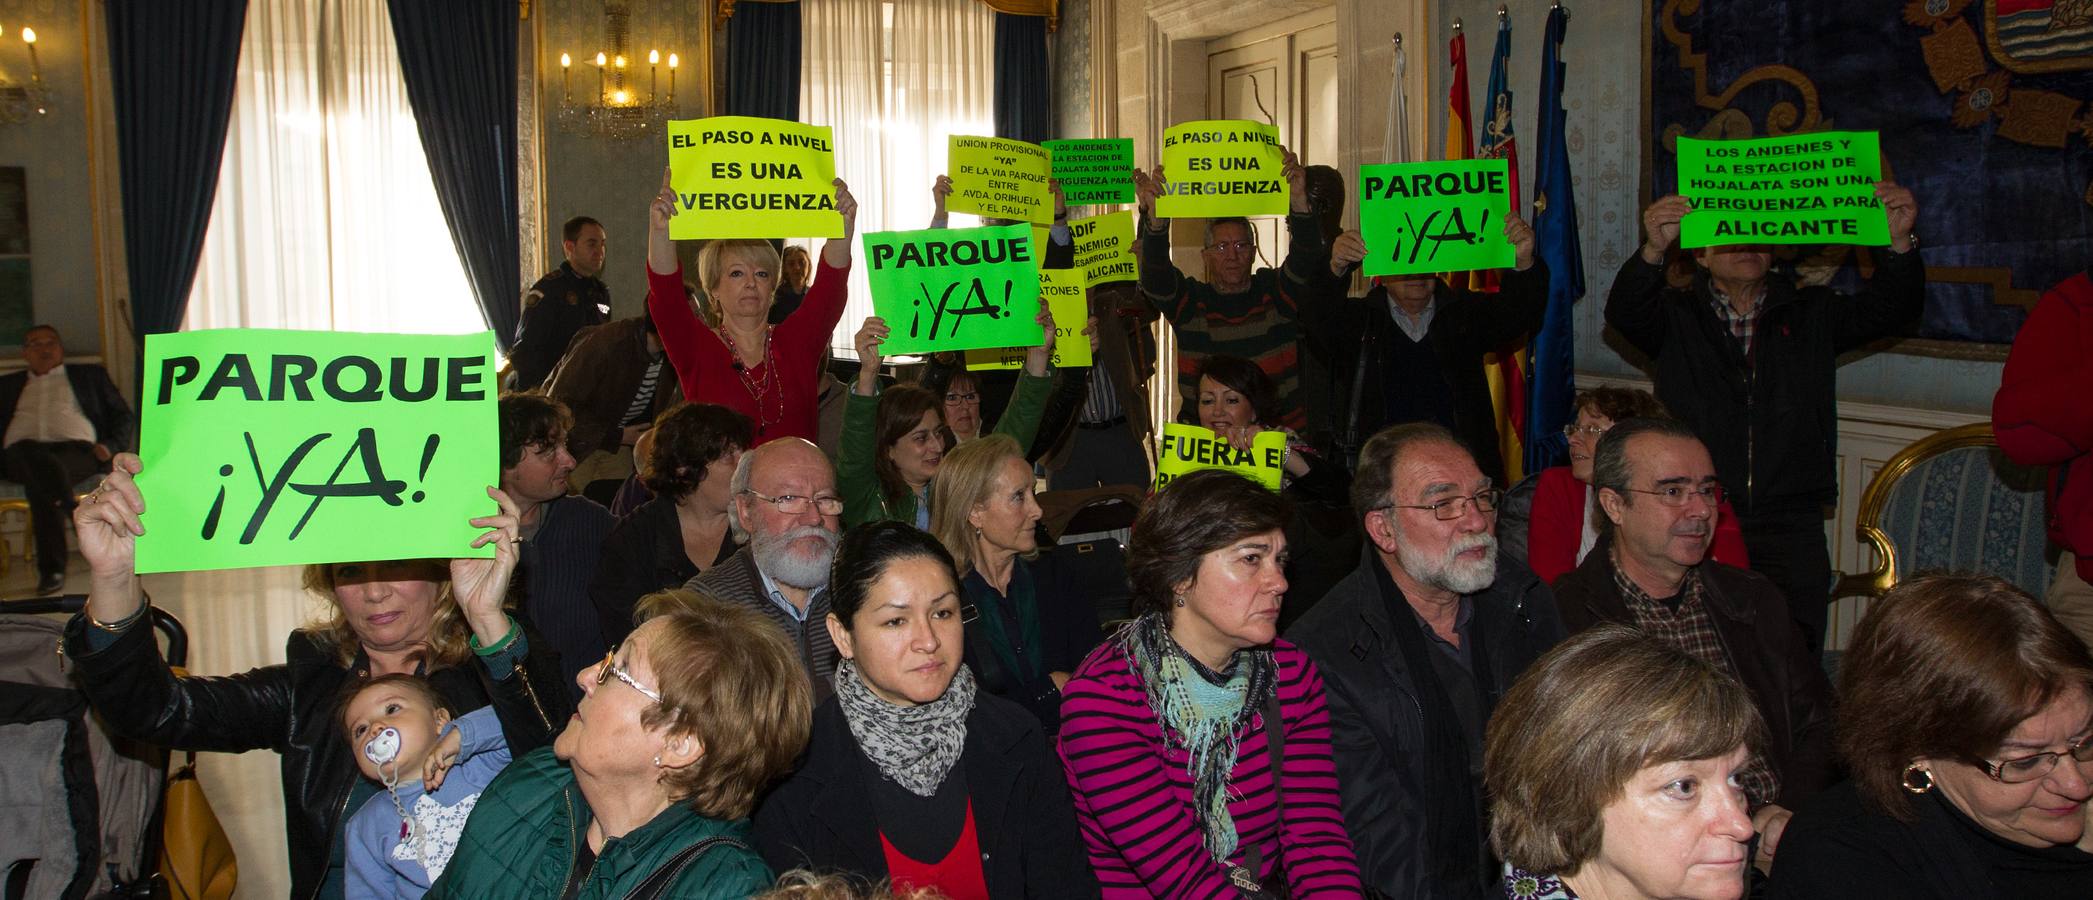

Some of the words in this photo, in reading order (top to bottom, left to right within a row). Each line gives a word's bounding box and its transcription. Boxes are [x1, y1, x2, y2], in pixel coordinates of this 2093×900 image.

[672, 134, 696, 149] EL
[702, 130, 754, 145] PASO
[760, 131, 774, 145] A
[779, 132, 832, 153] NIVEL
[1054, 144, 1069, 152] LOS
[1073, 143, 1113, 151] ANDENES
[1115, 143, 1122, 151] Y
[1164, 135, 1178, 148] EL
[1182, 131, 1223, 144] PASO
[1227, 131, 1239, 143] A
[1243, 131, 1280, 147] NIVEL
[1705, 147, 1740, 158] LOS
[1745, 140, 1834, 158] ANDENES
[1839, 139, 1852, 150] Y
[956, 139, 988, 149] UNION
[990, 141, 1049, 160] PROVISIONAL
[1066, 154, 1109, 162] ESTACION
[711, 162, 743, 180] ES
[750, 162, 803, 180] UNA
[1052, 165, 1090, 173] OJALATA
[1112, 164, 1131, 172] UNA
[1188, 157, 1213, 171] ES
[1219, 157, 1261, 171] UNA
[1705, 164, 1728, 174] LA
[1733, 158, 1825, 175] ESTACION
[1832, 157, 1857, 168] DE
[960, 165, 974, 174] DE
[976, 167, 989, 176] LA
[991, 169, 1007, 177] VIA
[1009, 171, 1046, 183] PARQUE
[1058, 176, 1108, 185] RGUENZA
[1690, 178, 1784, 191] HOJALATA
[1789, 178, 1829, 189] SON
[1836, 175, 1875, 186] UNA
[988, 180, 1019, 191] ENTRE
[1165, 180, 1282, 196] VERGUENZA
[1365, 170, 1504, 201] PARQUE
[680, 192, 835, 211] VERGUENZA
[963, 189, 992, 200] AVDA.
[994, 192, 1041, 206] ORIHUELA
[1065, 190, 1122, 201] LICANTE
[1688, 196, 1827, 211] VERGUENZA
[1833, 195, 1881, 210] PARA
[978, 202, 985, 211] Y
[987, 204, 999, 213] EL
[1001, 205, 1028, 216] PAU-1
[1068, 221, 1096, 238] ADIF
[1391, 207, 1490, 265] ¡YA!
[1714, 218, 1859, 237] ALICANTE
[871, 236, 1031, 271] PARQUE
[1073, 236, 1119, 255] ENEMIGO
[1074, 250, 1119, 268] ESARROLLO
[1087, 262, 1135, 281] ALICANTE
[1039, 286, 1080, 296] ATONES
[909, 277, 1013, 341] ¡YA!
[1065, 327, 1073, 337] Y
[156, 352, 486, 406] PARQUE
[1161, 434, 1257, 467] FUERA
[200, 427, 441, 546] ¡YA!
